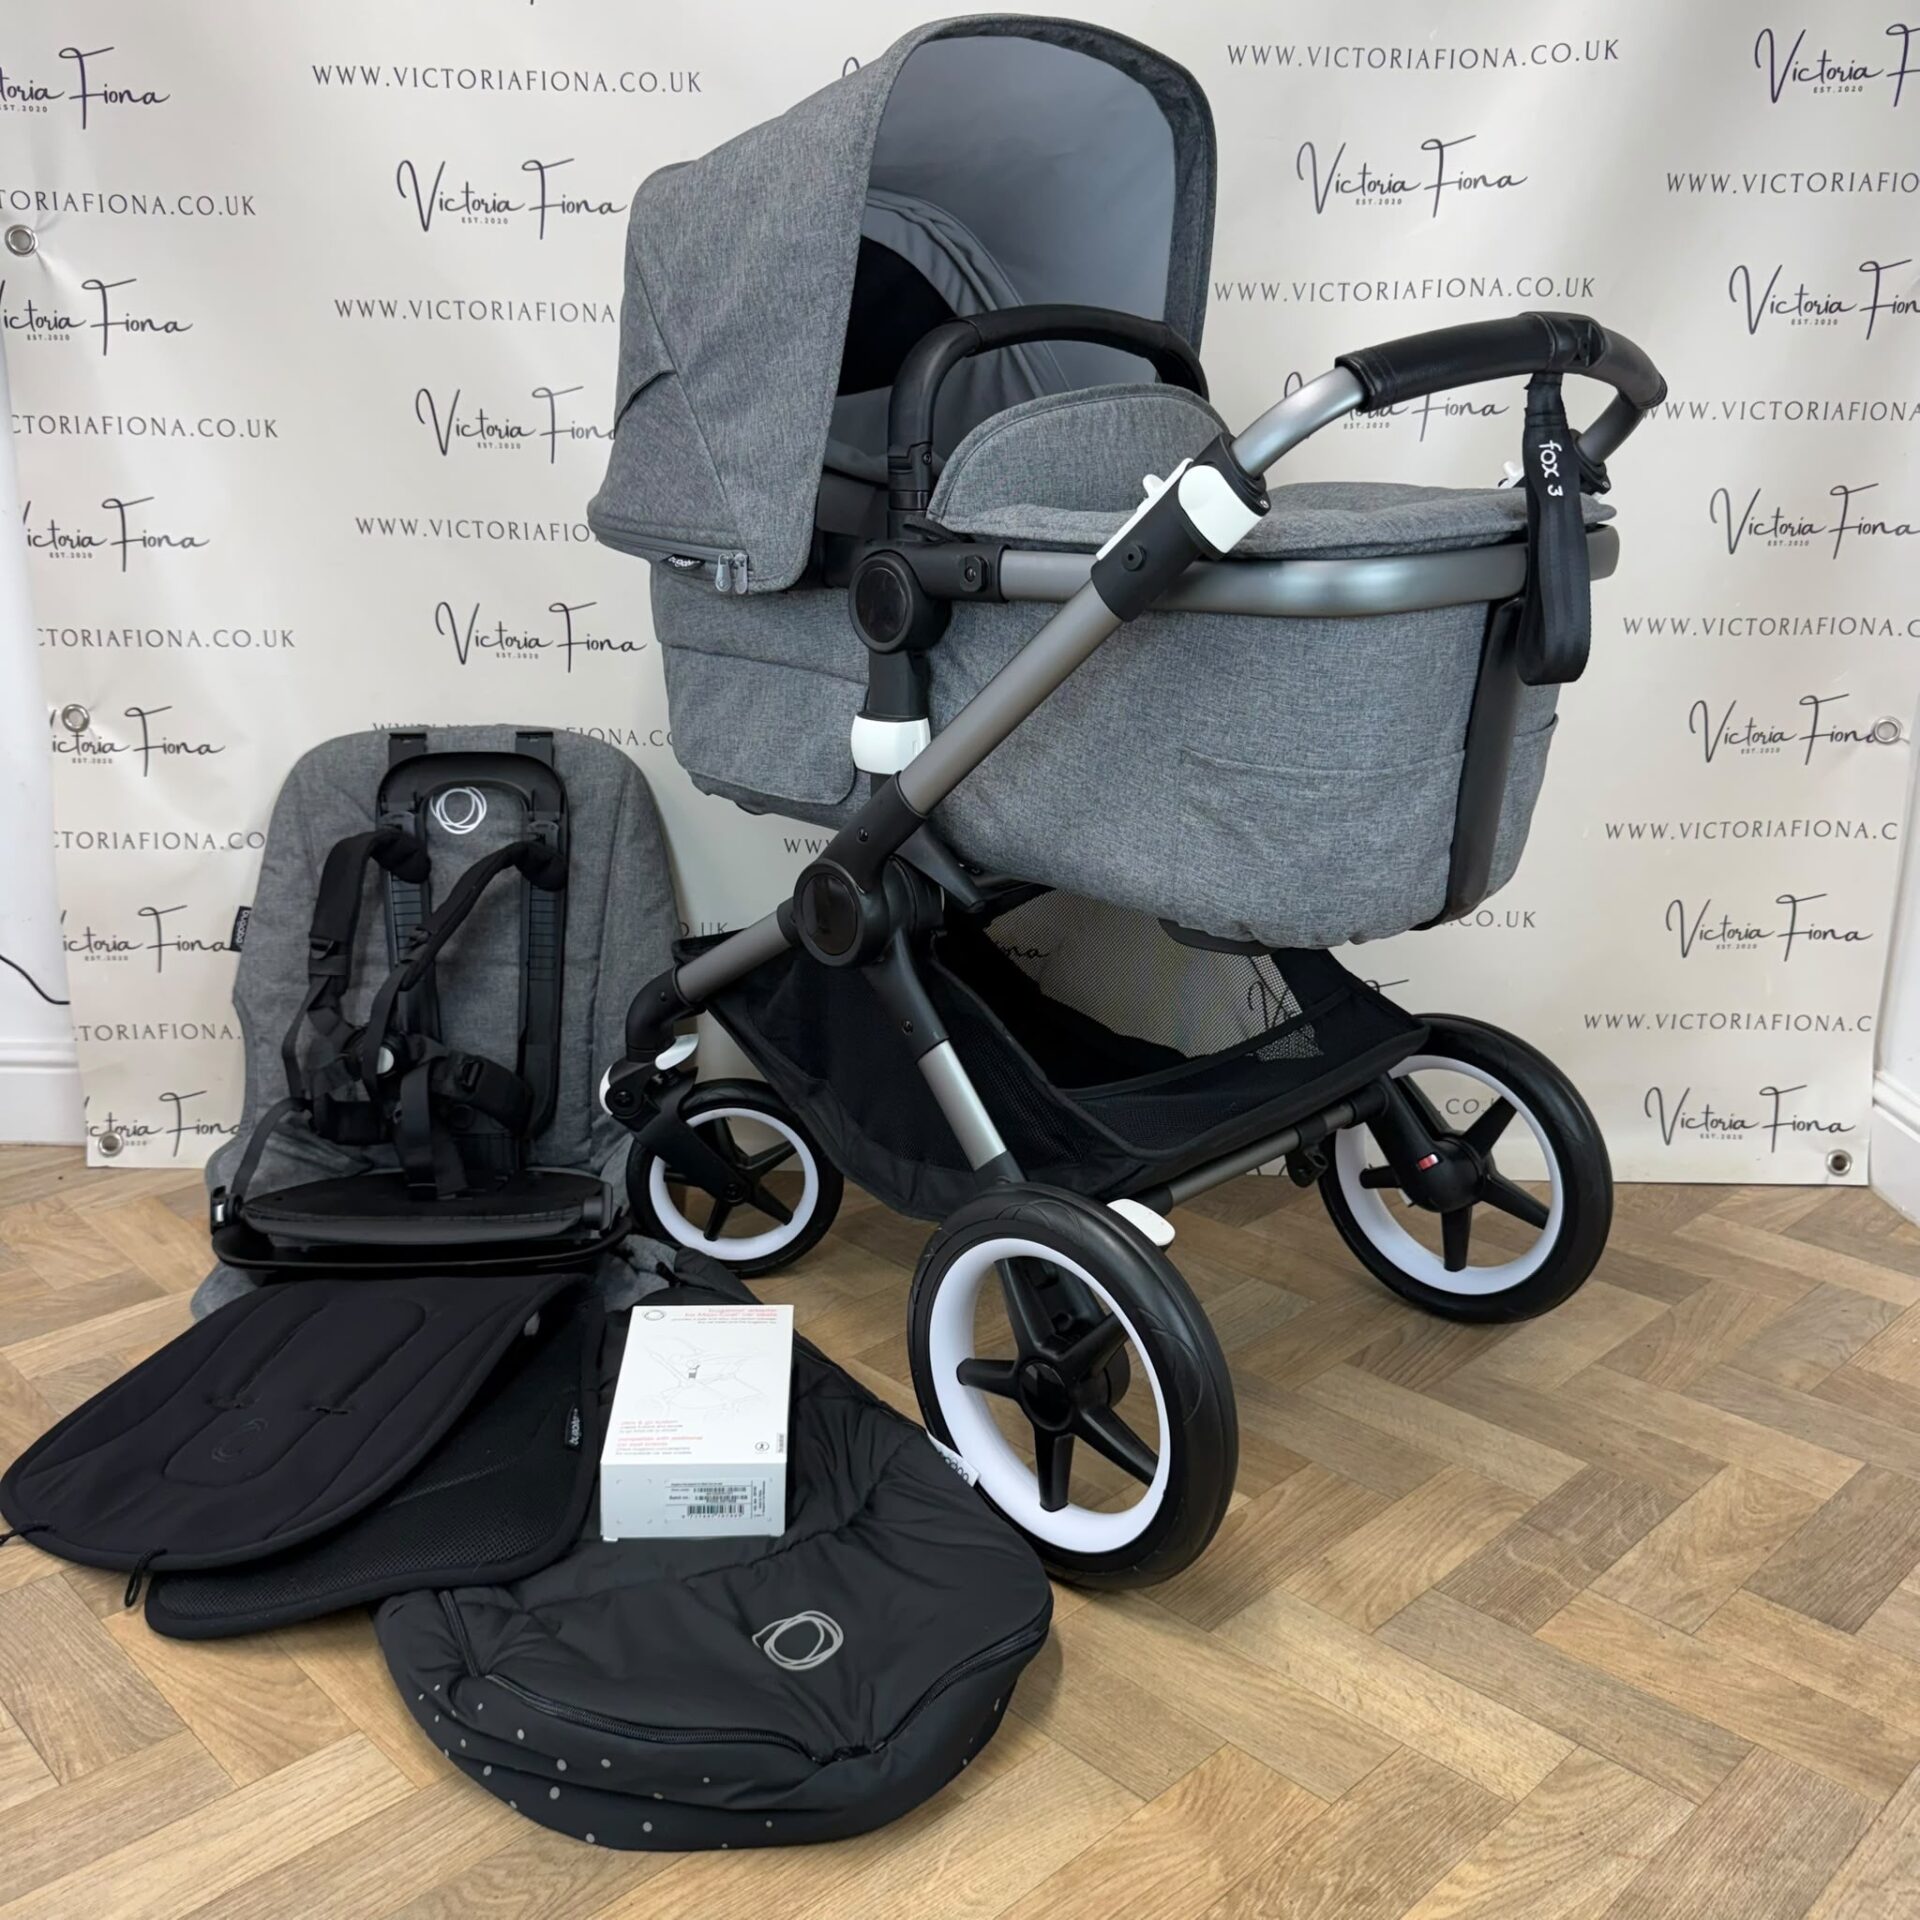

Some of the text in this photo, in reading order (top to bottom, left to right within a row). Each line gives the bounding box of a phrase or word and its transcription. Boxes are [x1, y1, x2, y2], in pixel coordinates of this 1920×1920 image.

[311, 64, 702, 94] WWW.VICTORIAFIONA.CO.UK
[1226, 38, 1619, 70] WWW.VICTORIAFIONA.CO.UK
[1754, 27, 1885, 105] Victoria
[0, 103, 48, 113] ST.2020
[57, 46, 171, 131] Fiona
[1813, 85, 1864, 94] EST.2020
[395, 157, 628, 241] Victoria Fiona
[1295, 134, 1530, 219] Victoria Fiona
[1666, 171, 1920, 195] WWW.VICTORIAFIO
[0, 277, 194, 357] ictoria Fiona
[333, 298, 616, 324] WWW.VICTORIAFIONA
[1214, 276, 1596, 303] WWW.VICTORIAFIONA.CO.UK
[1728, 264, 1858, 336] Victoria
[414, 387, 537, 457] Victoria
[1538, 440, 1564, 497] fox 3
[22, 496, 210, 573] ictoria Fiona
[354, 516, 600, 543] WWW.VICTORIAFIO
[1709, 487, 1827, 556] Victoria
[434, 601, 648, 674] Victoria Fiona
[48, 705, 226, 778] ictoria Fiona
[1688, 699, 1798, 764] Victoria
[1605, 819, 1898, 841] WWW.VICTORIAFIONA.C
[60, 909, 144, 954] ictoria
[1664, 892, 1874, 963] Victoria Fiona
[73, 1022, 241, 1042] TORIAFIONA.
[1583, 1012, 1873, 1033] WWW.VICTORIAFIONA.C
[1643, 1084, 1858, 1154] Victoria Fiona
